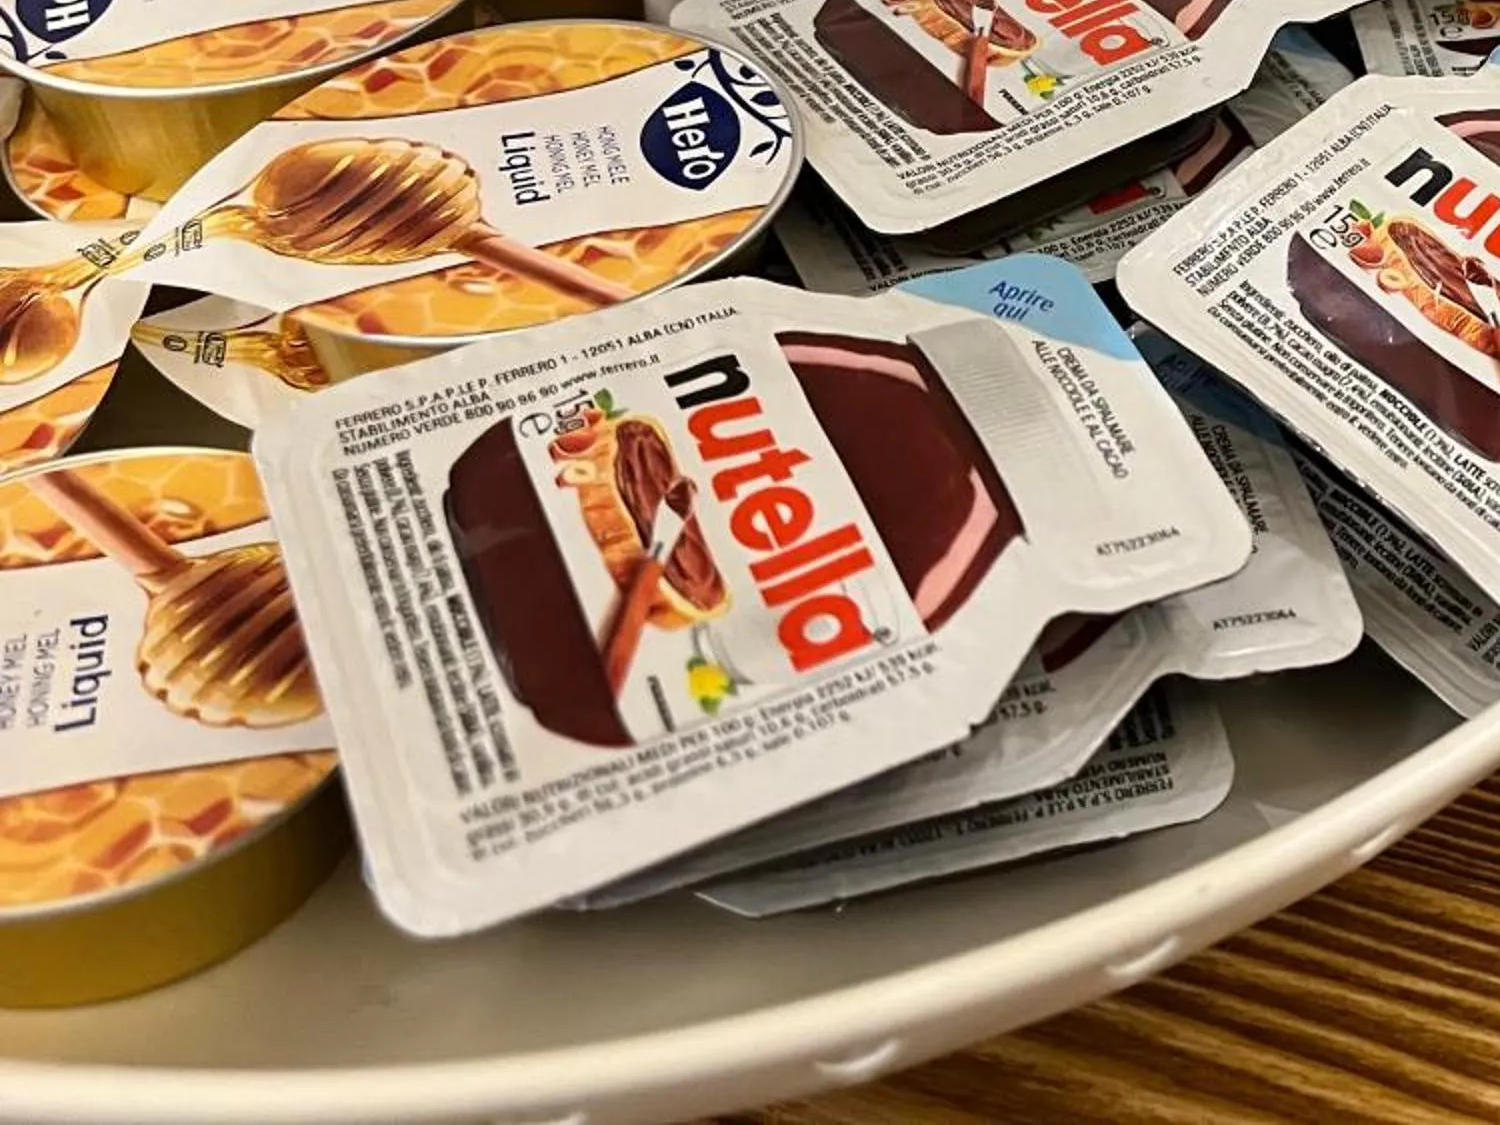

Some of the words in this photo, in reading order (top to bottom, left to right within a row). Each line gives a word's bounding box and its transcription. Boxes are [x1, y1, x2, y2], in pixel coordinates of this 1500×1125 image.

[498, 130, 547, 206] Liquid
[662, 97, 720, 183] Hero
[1172, 240, 1216, 278] FERRERO
[1258, 175, 1299, 211] FERRERO
[1330, 132, 1355, 155] ALBA
[1319, 203, 1363, 250] 15g
[1184, 232, 1250, 288] STABILIMENTO
[1245, 214, 1273, 239] ALBA
[1195, 260, 1238, 298] NUMERO
[1233, 237, 1267, 267] VERDE
[1262, 224, 1283, 244] 800
[988, 280, 1055, 315] Aprire
[992, 300, 1028, 325] qui
[334, 401, 402, 432] FERRERO
[493, 355, 558, 386] FERRERO
[581, 337, 624, 359] 12051
[626, 326, 662, 346] ALBA
[663, 316, 695, 336] (CN)
[694, 304, 737, 326] ITALIA
[1029, 335, 1057, 368] ALLE
[1047, 361, 1087, 412] NOCCIOLE
[1085, 421, 1103, 440] AL
[1094, 437, 1128, 481] CACAO
[1056, 344, 1087, 383] CREMA
[1077, 377, 1098, 399] DA
[1090, 395, 1135, 457] SPALMARE
[338, 400, 449, 445] STABILIMENTO
[451, 388, 491, 411] ALBA
[342, 427, 410, 457] NUMERO
[412, 412, 461, 436] VERDE
[463, 402, 493, 421] 800
[517, 390, 537, 406] 96
[538, 382, 558, 398] 90
[1377, 386, 1428, 432] NOCCIOLE
[1452, 450, 1486, 482] LATTE
[663, 352, 878, 673] nutella
[53, 612, 111, 735] Liquid
